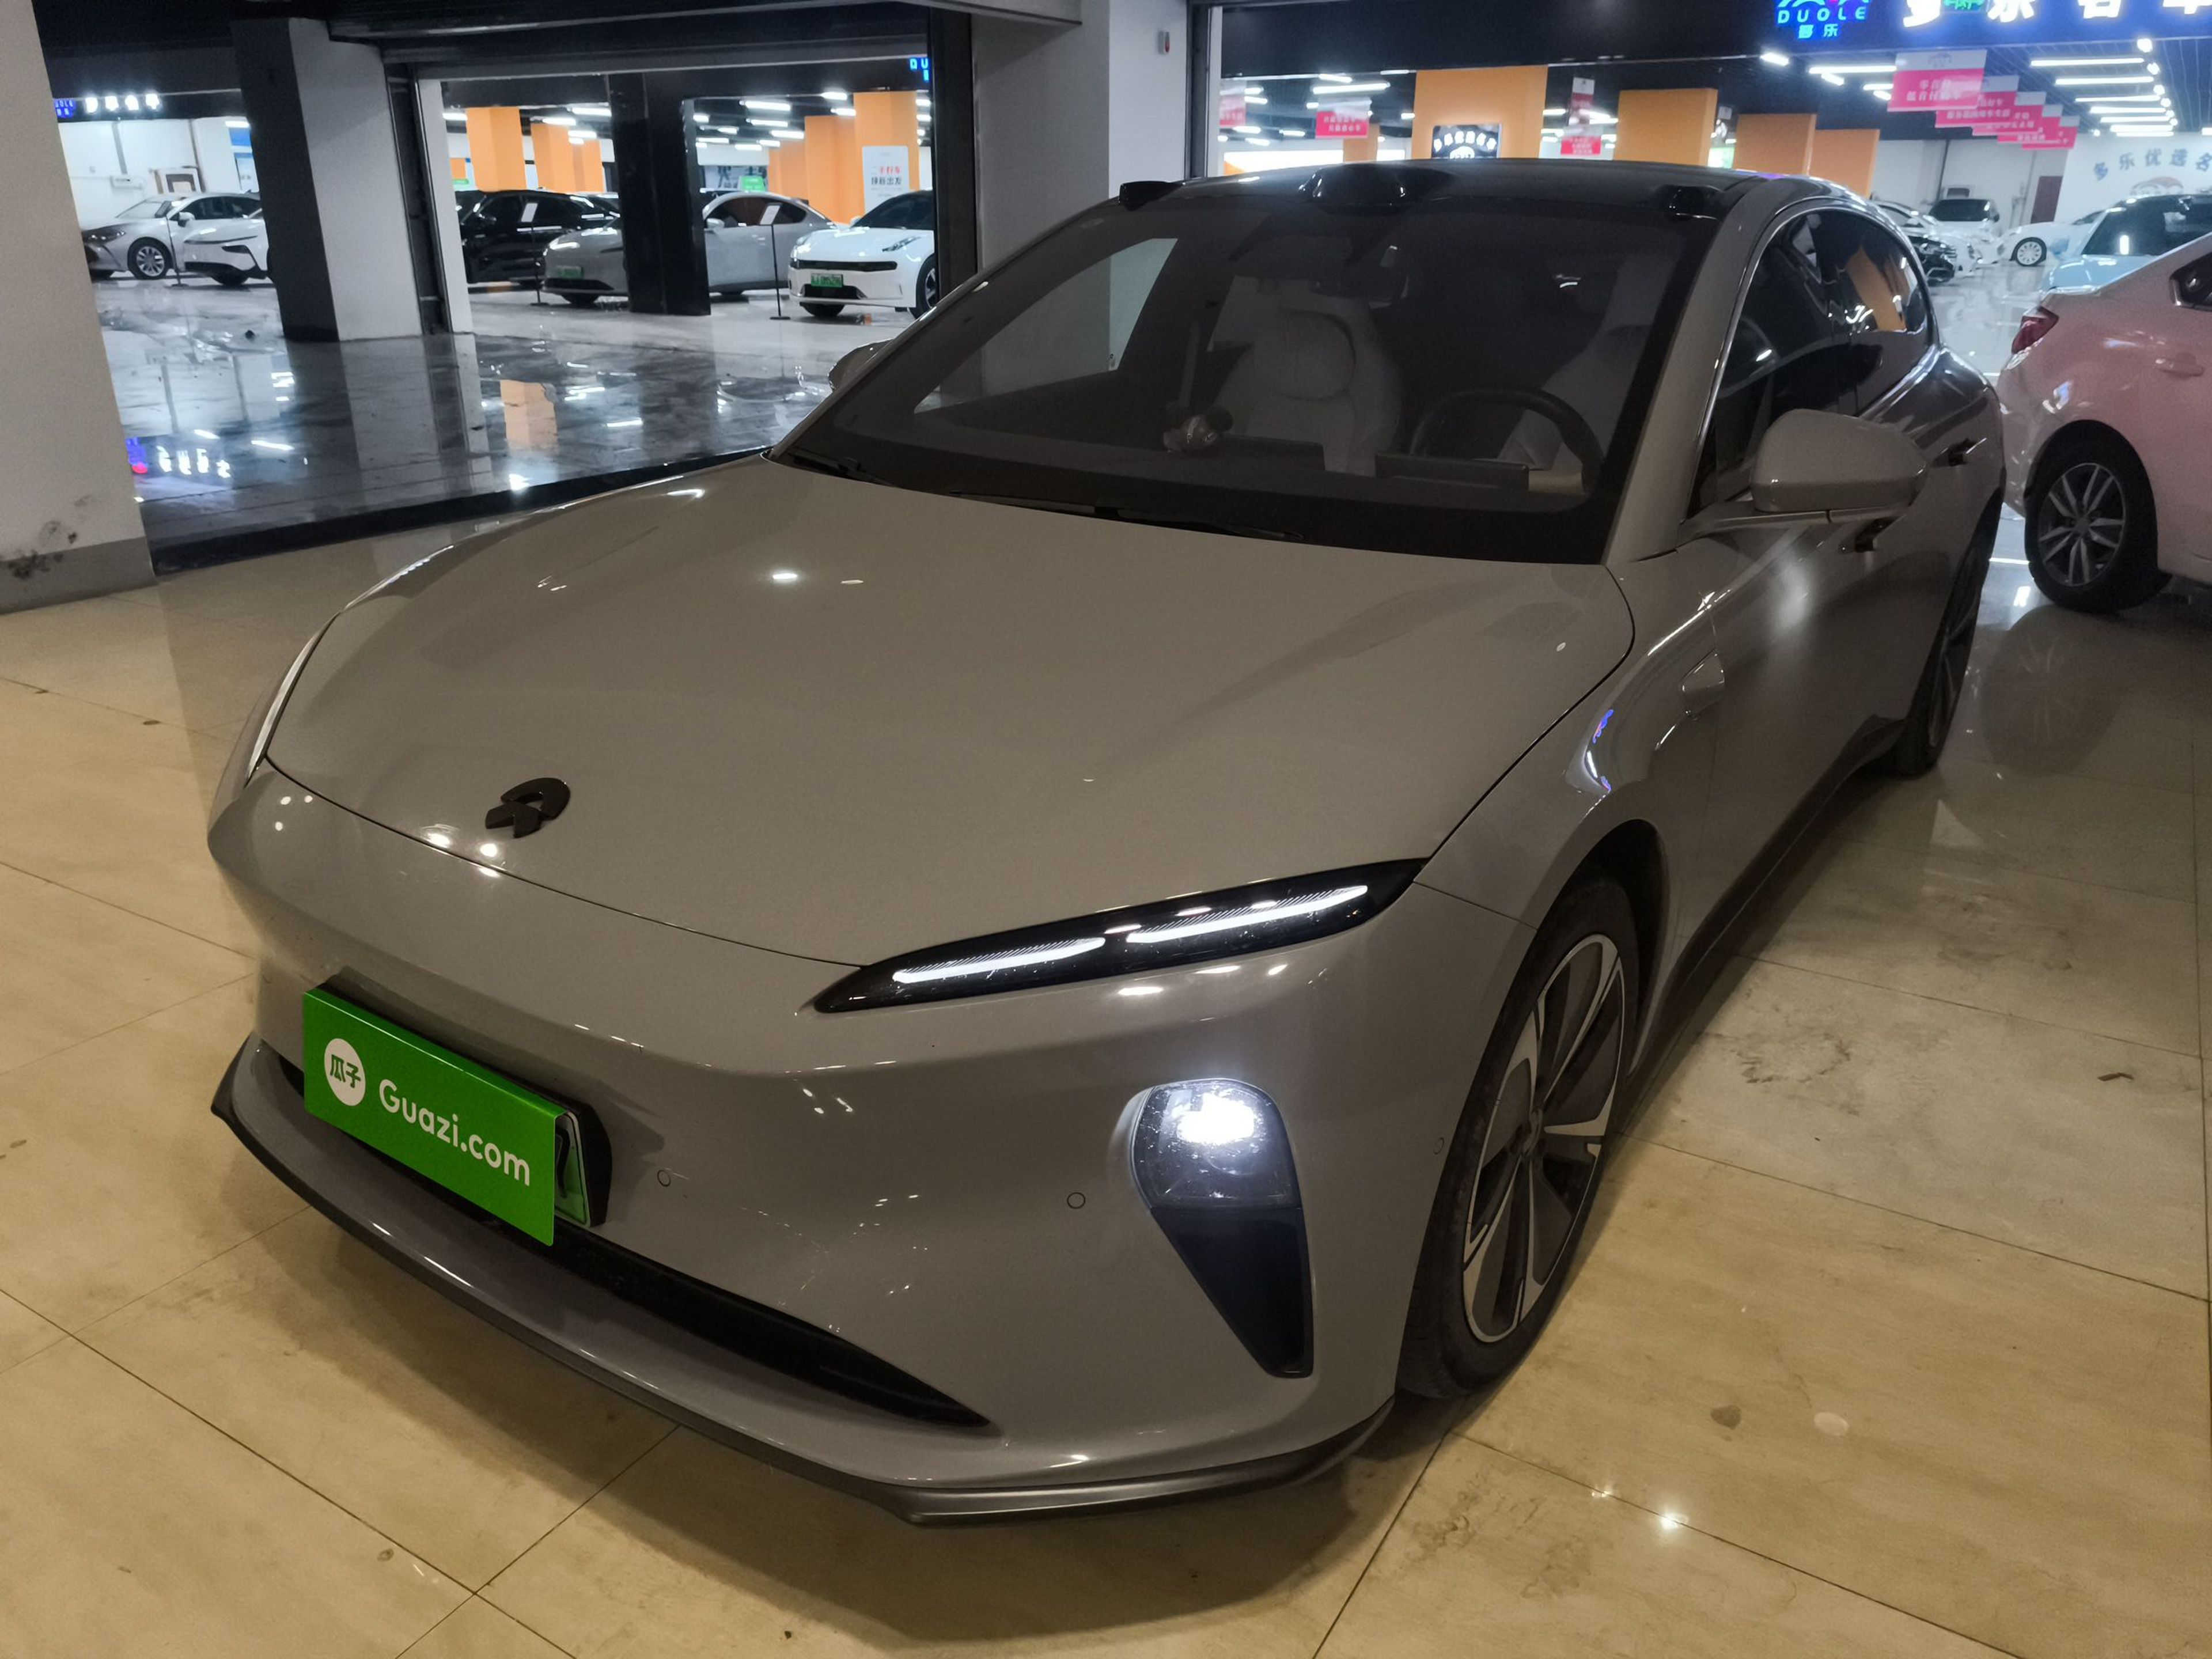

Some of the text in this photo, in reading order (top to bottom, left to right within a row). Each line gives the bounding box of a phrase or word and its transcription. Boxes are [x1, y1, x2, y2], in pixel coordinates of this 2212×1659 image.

[1778, 7, 1866, 24] DUOLE
[1798, 24, 1838, 39] 多乐
[329, 1054, 362, 1089] 瓜子
[379, 1078, 530, 1187] Guazi.com
